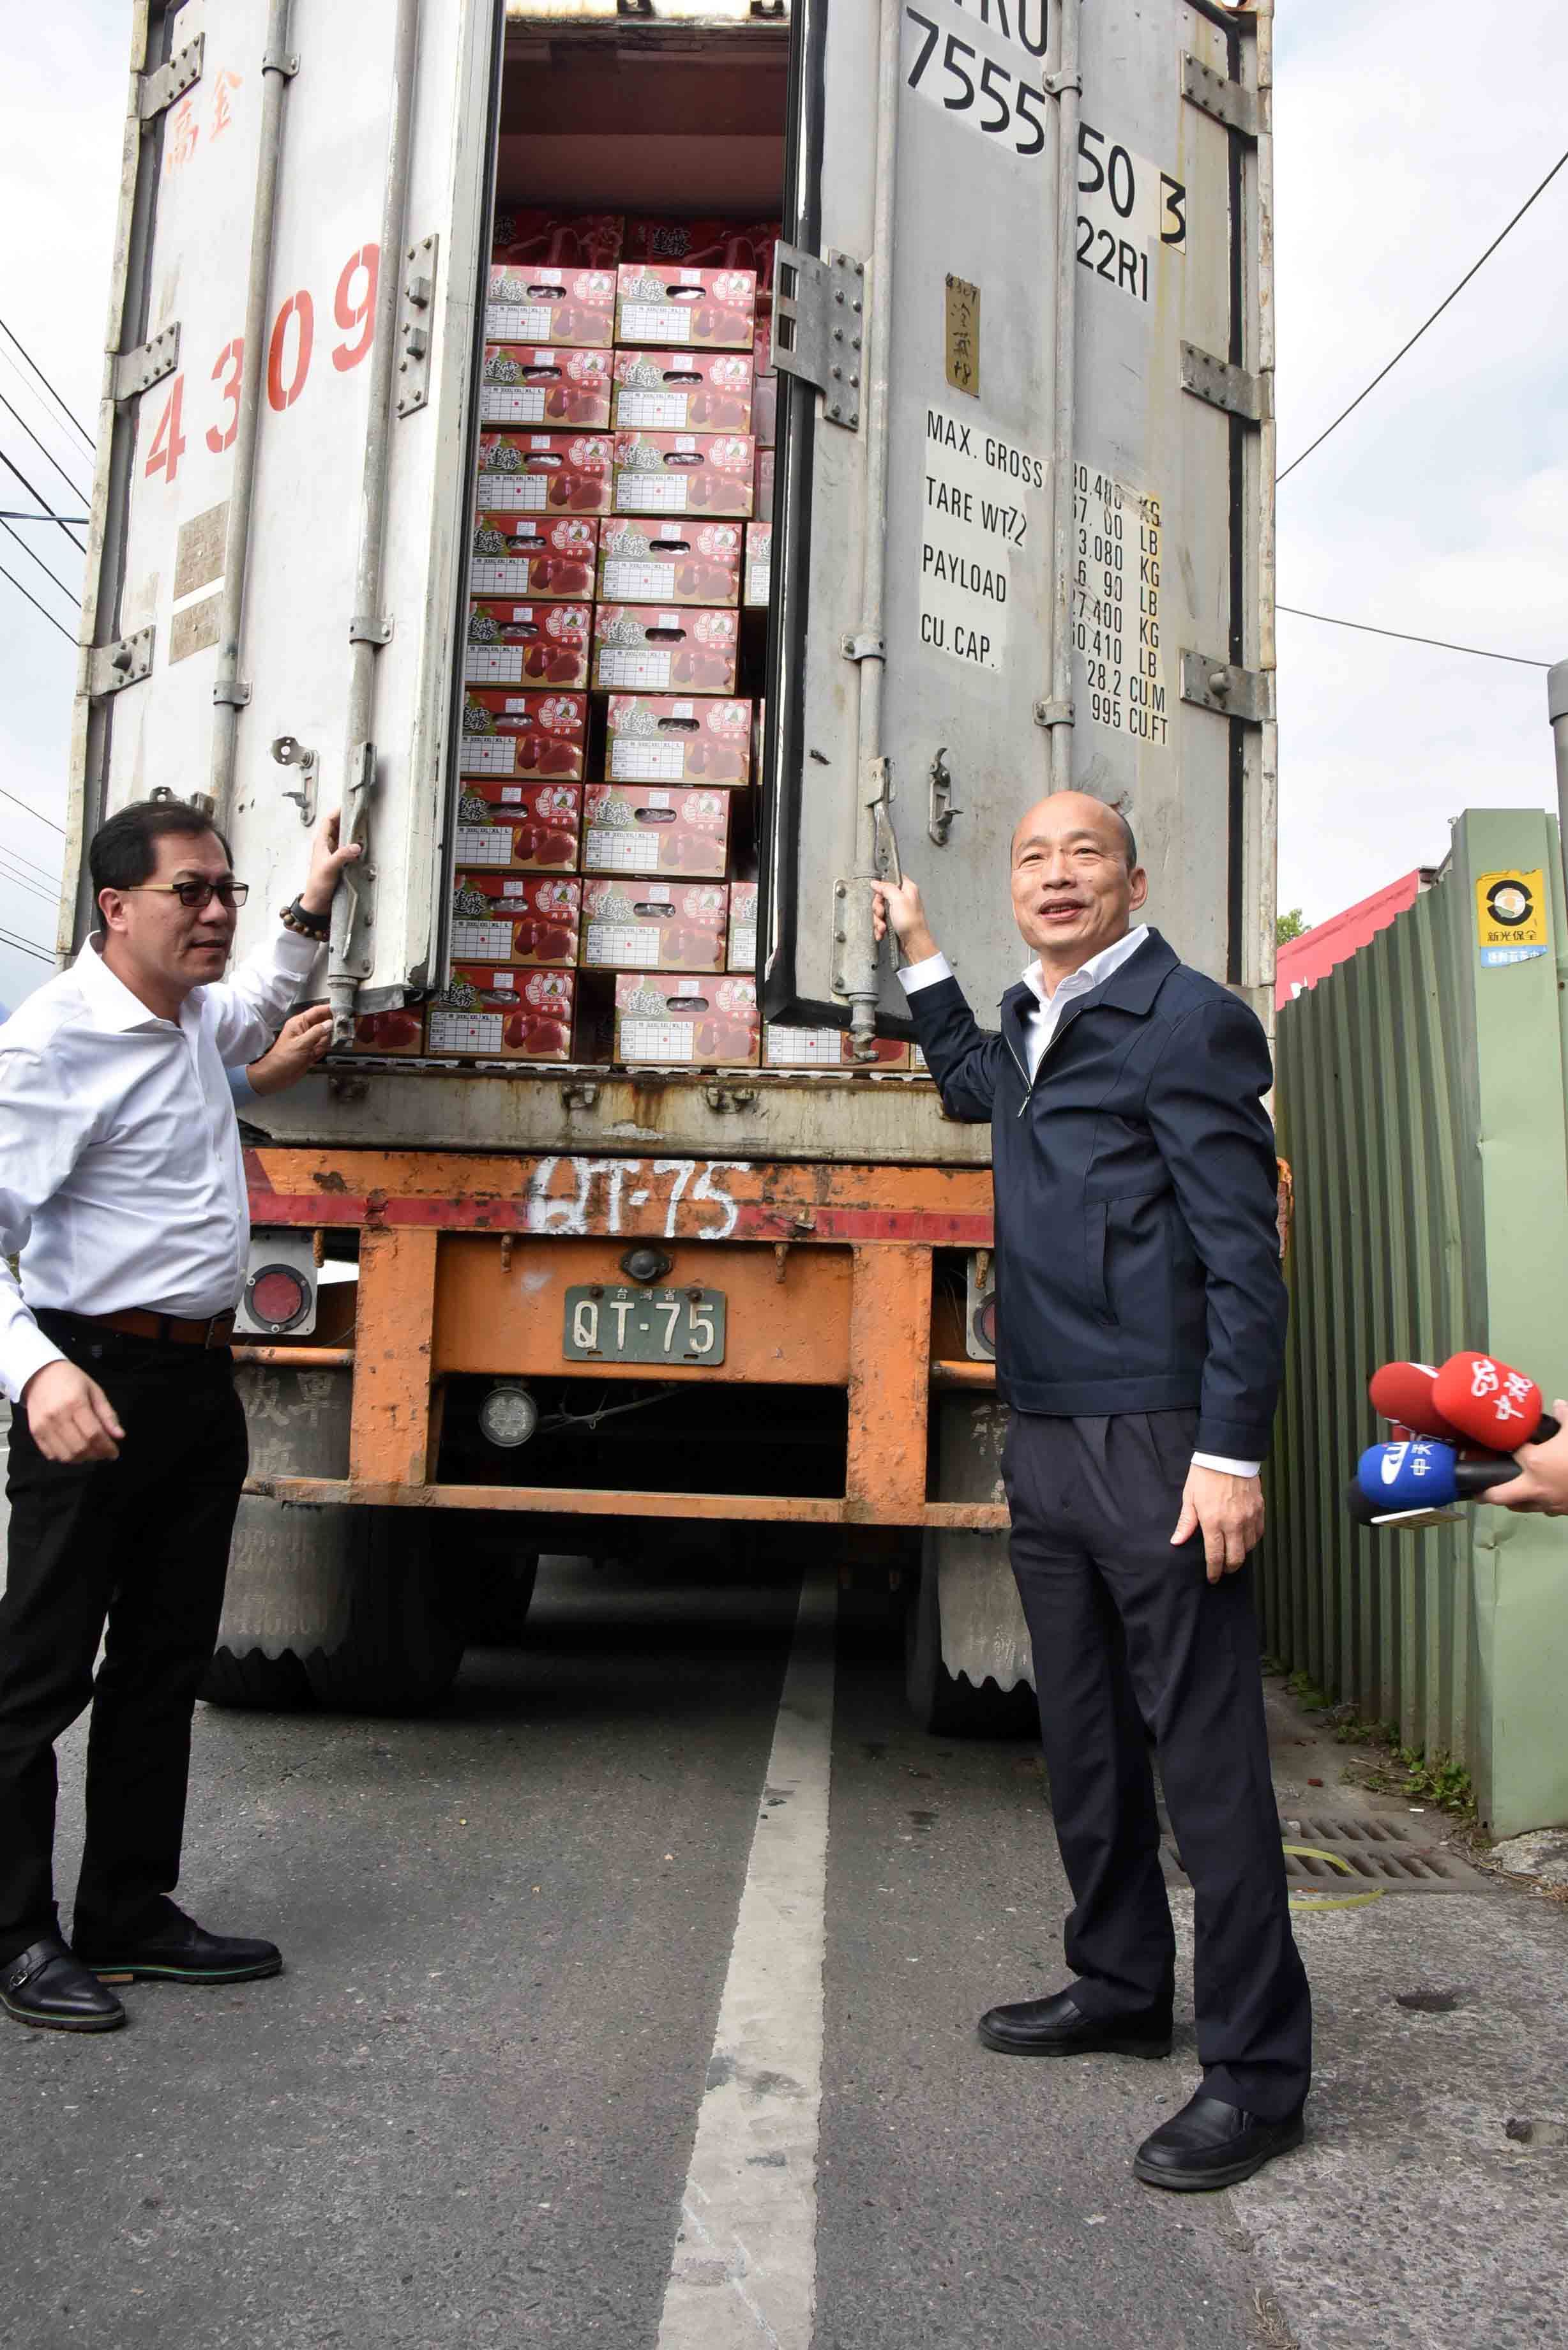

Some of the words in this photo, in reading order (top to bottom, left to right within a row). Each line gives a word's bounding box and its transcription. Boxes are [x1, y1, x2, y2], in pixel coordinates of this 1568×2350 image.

[1161, 172, 1186, 244] 3
[1076, 216, 1148, 302] 22R1
[928, 409, 977, 459] MAX.
[986, 438, 1043, 488] GROSS
[926, 476, 972, 523] TARE
[1079, 528, 1122, 571] 3.080
[1140, 555, 1159, 588] KG
[1140, 525, 1157, 556] LB
[923, 543, 1006, 603] PAYLOAD
[1140, 586, 1157, 617] LB
[921, 613, 995, 668] CU.CAP.
[1140, 616, 1159, 649] KG
[1087, 659, 1122, 697] 28.2
[1129, 676, 1165, 713] CU.M
[1140, 647, 1157, 678] LB
[1092, 694, 1121, 728] 995
[1129, 707, 1168, 745] CU.FT
[1487, 930, 1538, 942] 新光保全
[573, 1300, 715, 1353] QT-75
